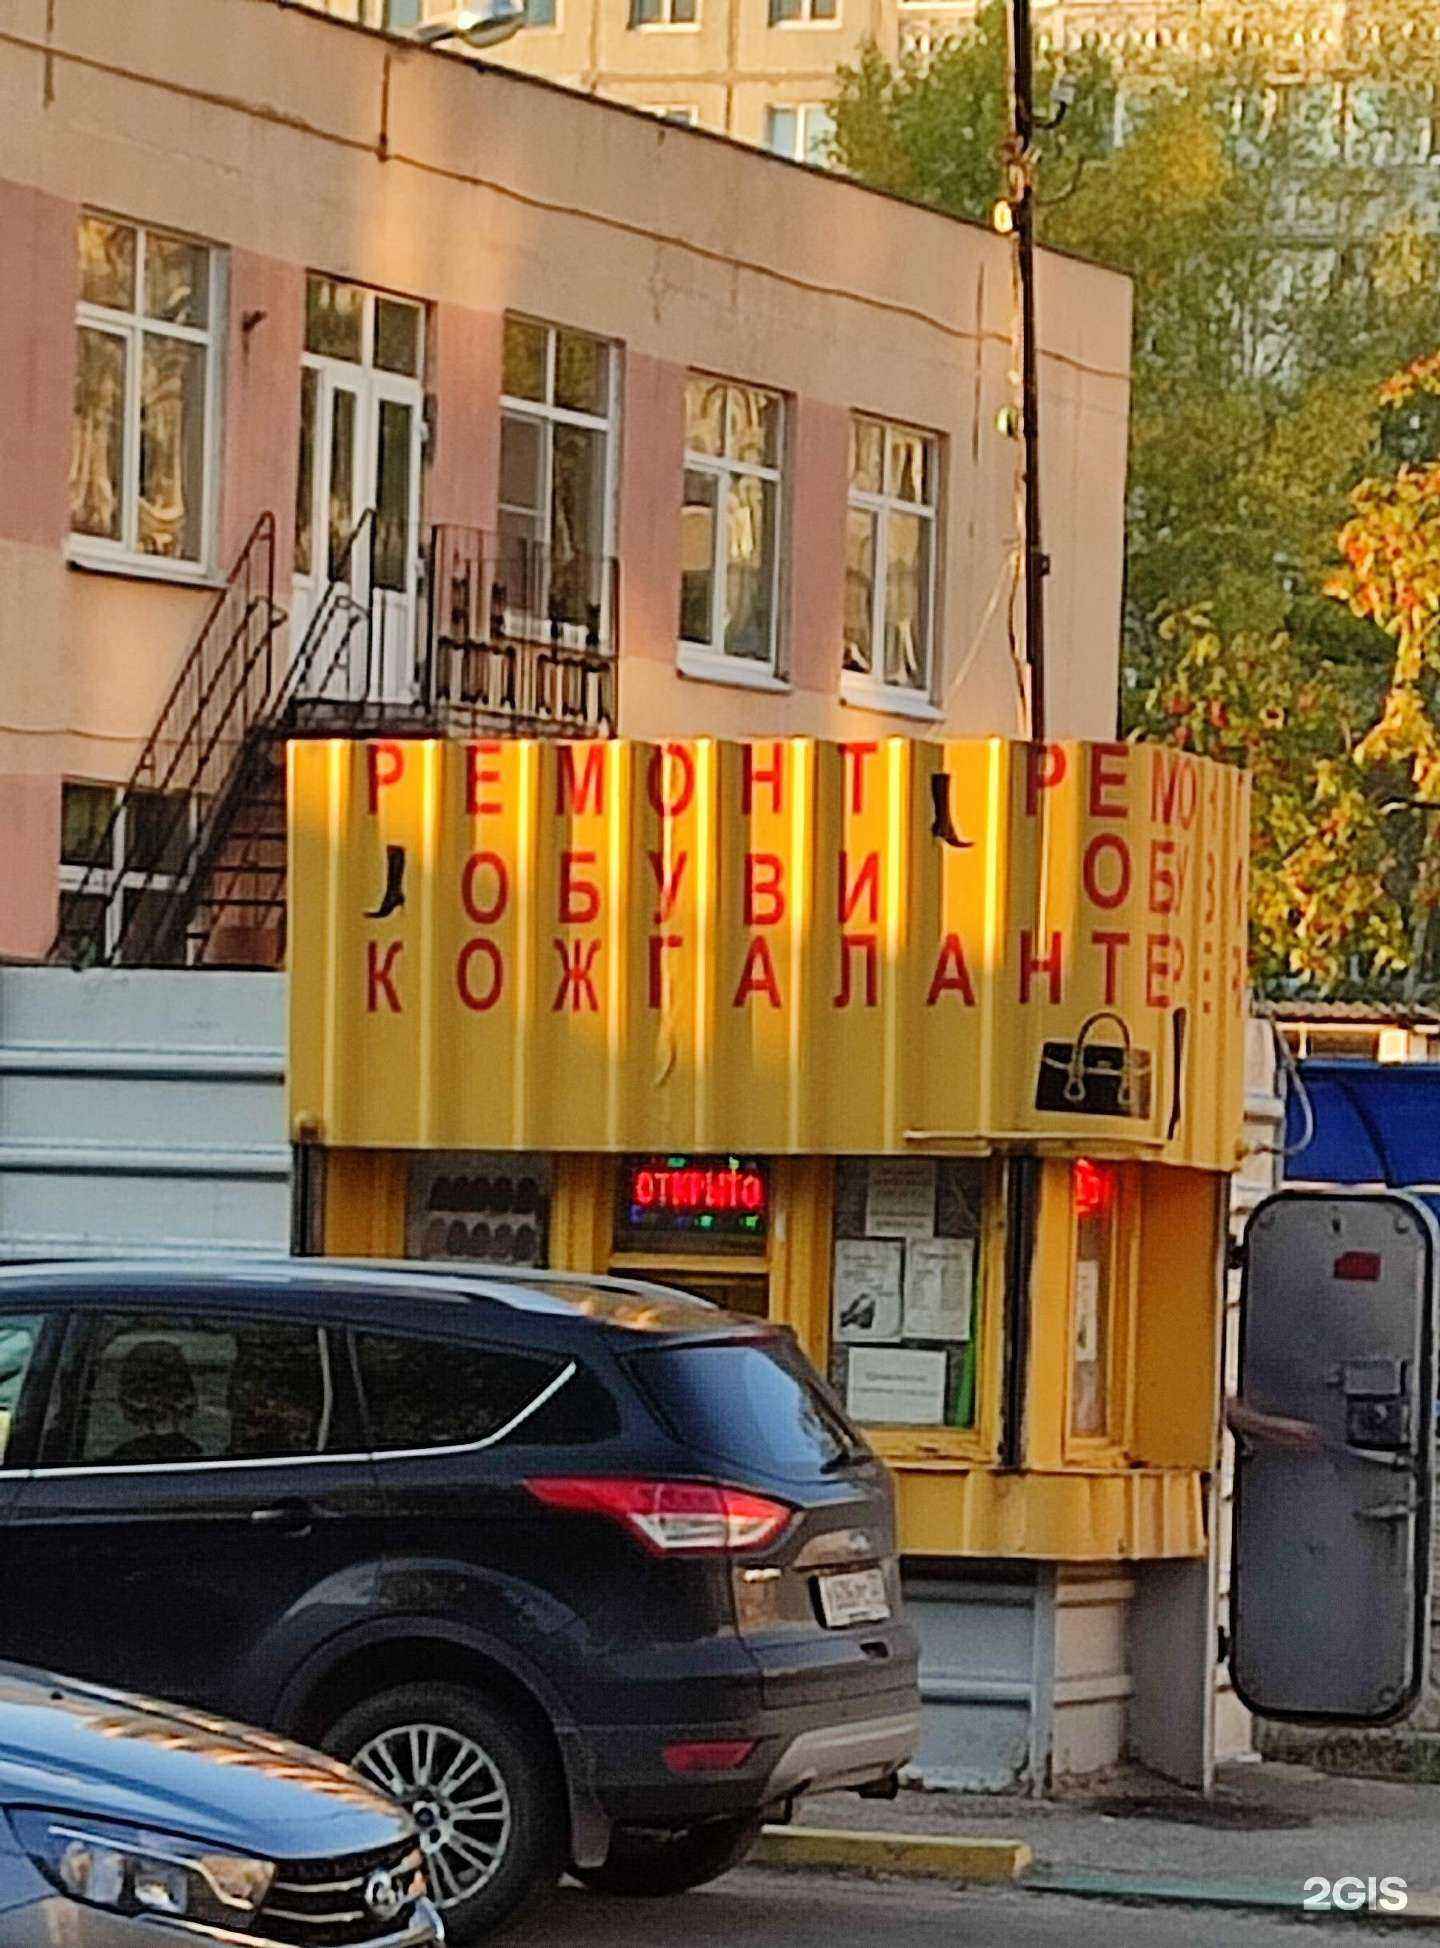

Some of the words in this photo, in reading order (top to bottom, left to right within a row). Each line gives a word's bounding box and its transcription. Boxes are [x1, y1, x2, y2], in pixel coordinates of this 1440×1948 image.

[366, 742, 877, 818] РЕМОНТ
[460, 850, 879, 925] ОБУВИ
[635, 1170, 764, 1209] ОТКРЫТО
